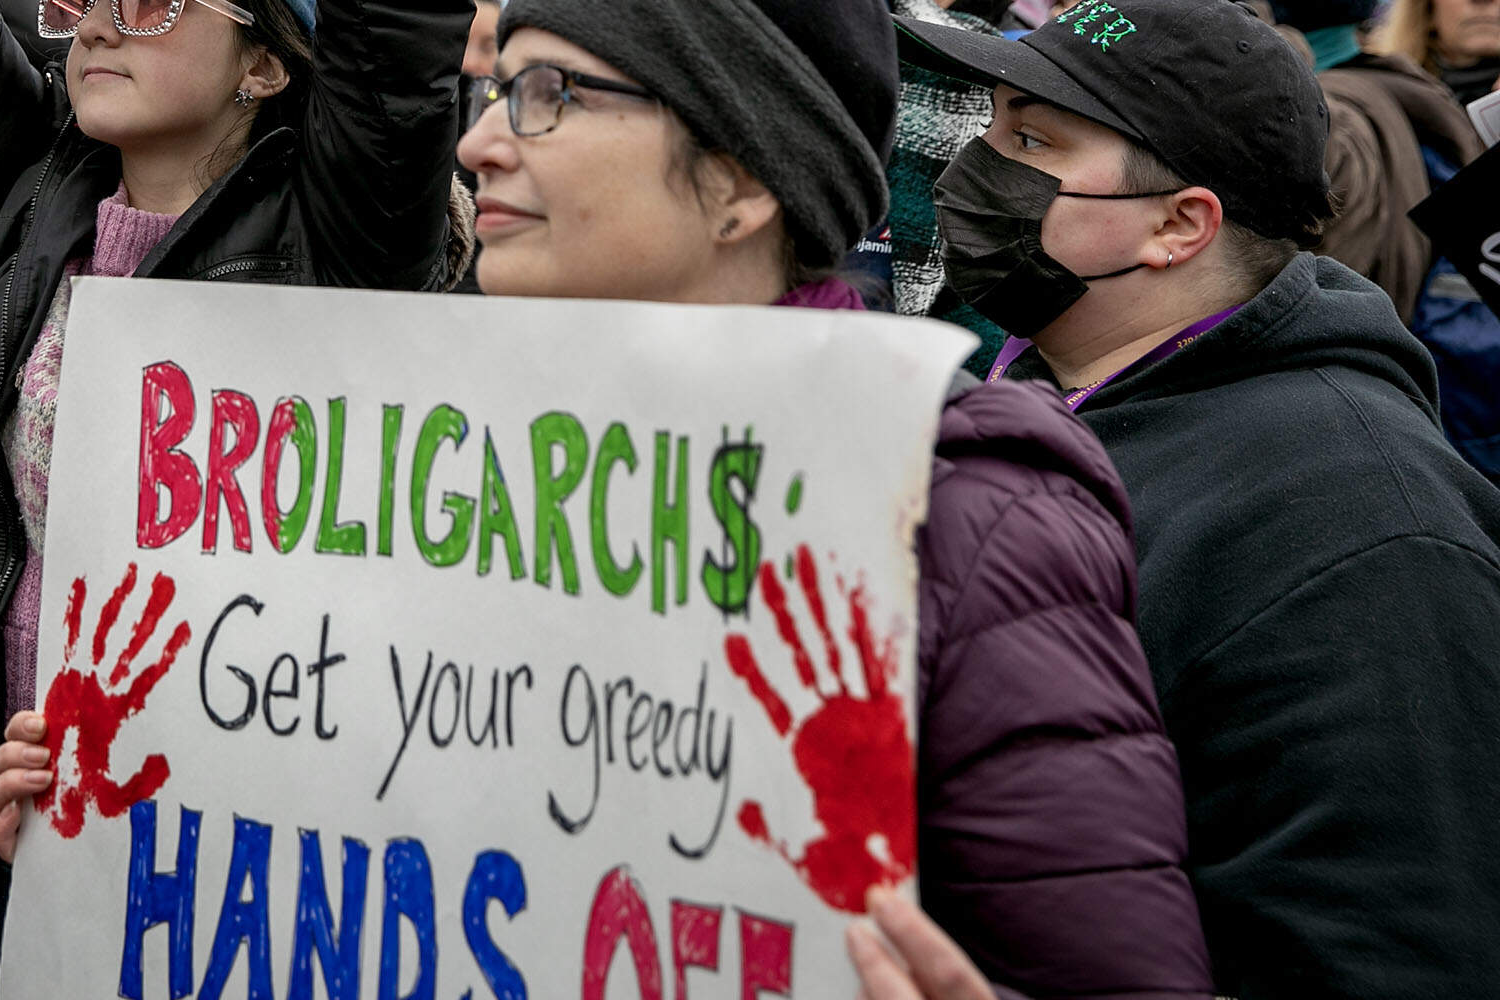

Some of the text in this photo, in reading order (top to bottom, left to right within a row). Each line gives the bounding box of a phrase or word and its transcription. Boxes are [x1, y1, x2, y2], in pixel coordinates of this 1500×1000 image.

[199, 594, 734, 860] Get your greedy
[117, 799, 528, 1000] HANDS
